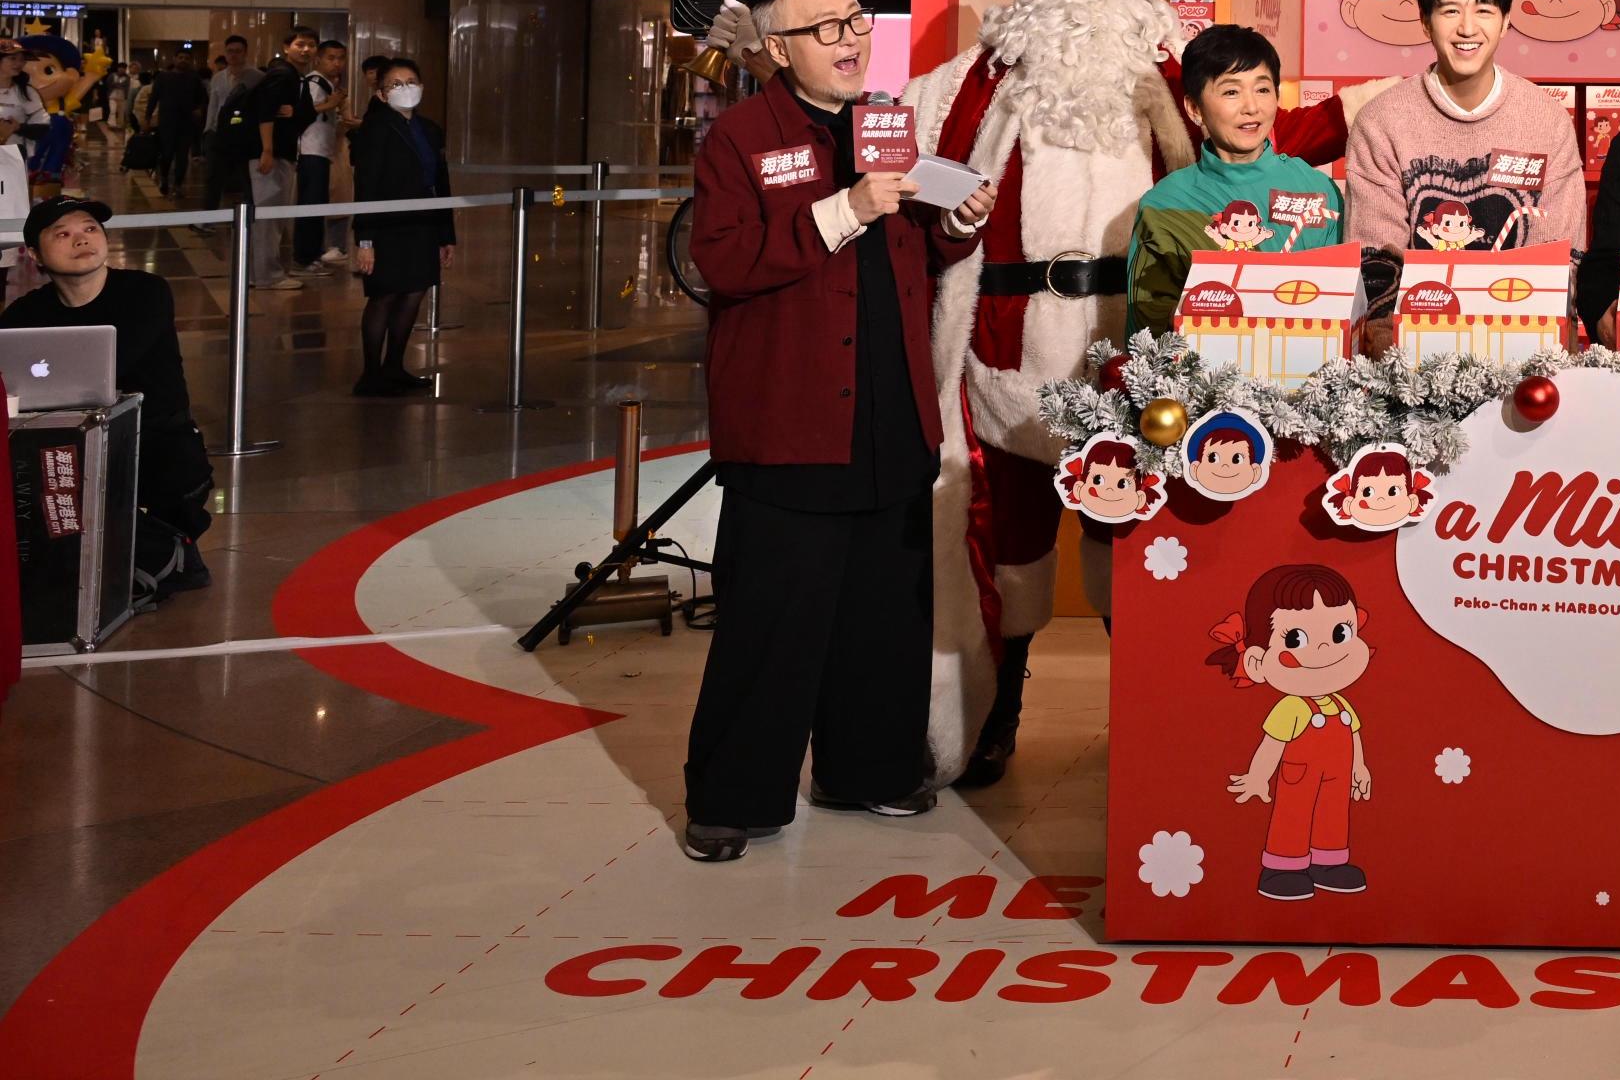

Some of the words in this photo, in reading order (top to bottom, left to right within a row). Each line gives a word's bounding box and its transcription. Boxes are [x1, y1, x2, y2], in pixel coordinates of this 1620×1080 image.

[861, 112, 908, 129] 海港城
[861, 129, 892, 138] HARBOUR
[893, 129, 908, 138] CITY
[760, 149, 810, 175] 海港城
[1493, 154, 1545, 176] 海港城
[763, 171, 798, 185] HARBOUR
[798, 167, 815, 179] CITY
[1490, 173, 1524, 186] HARBOUR
[1525, 176, 1542, 187] CITY
[1272, 195, 1323, 213] 海港城
[1272, 212, 1305, 223] HARBOU
[1197, 289, 1236, 306] Milky
[1415, 289, 1453, 305] Milky
[45, 451, 56, 478] HARBOUR
[55, 449, 76, 489] 海港城
[47, 477, 58, 491] CITY
[45, 495, 58, 521] HARBOUR
[55, 493, 80, 531] 海港城
[51, 521, 62, 534] CITY
[1435, 501, 1480, 541] a
[1454, 596, 1538, 612] Peko-Chan
